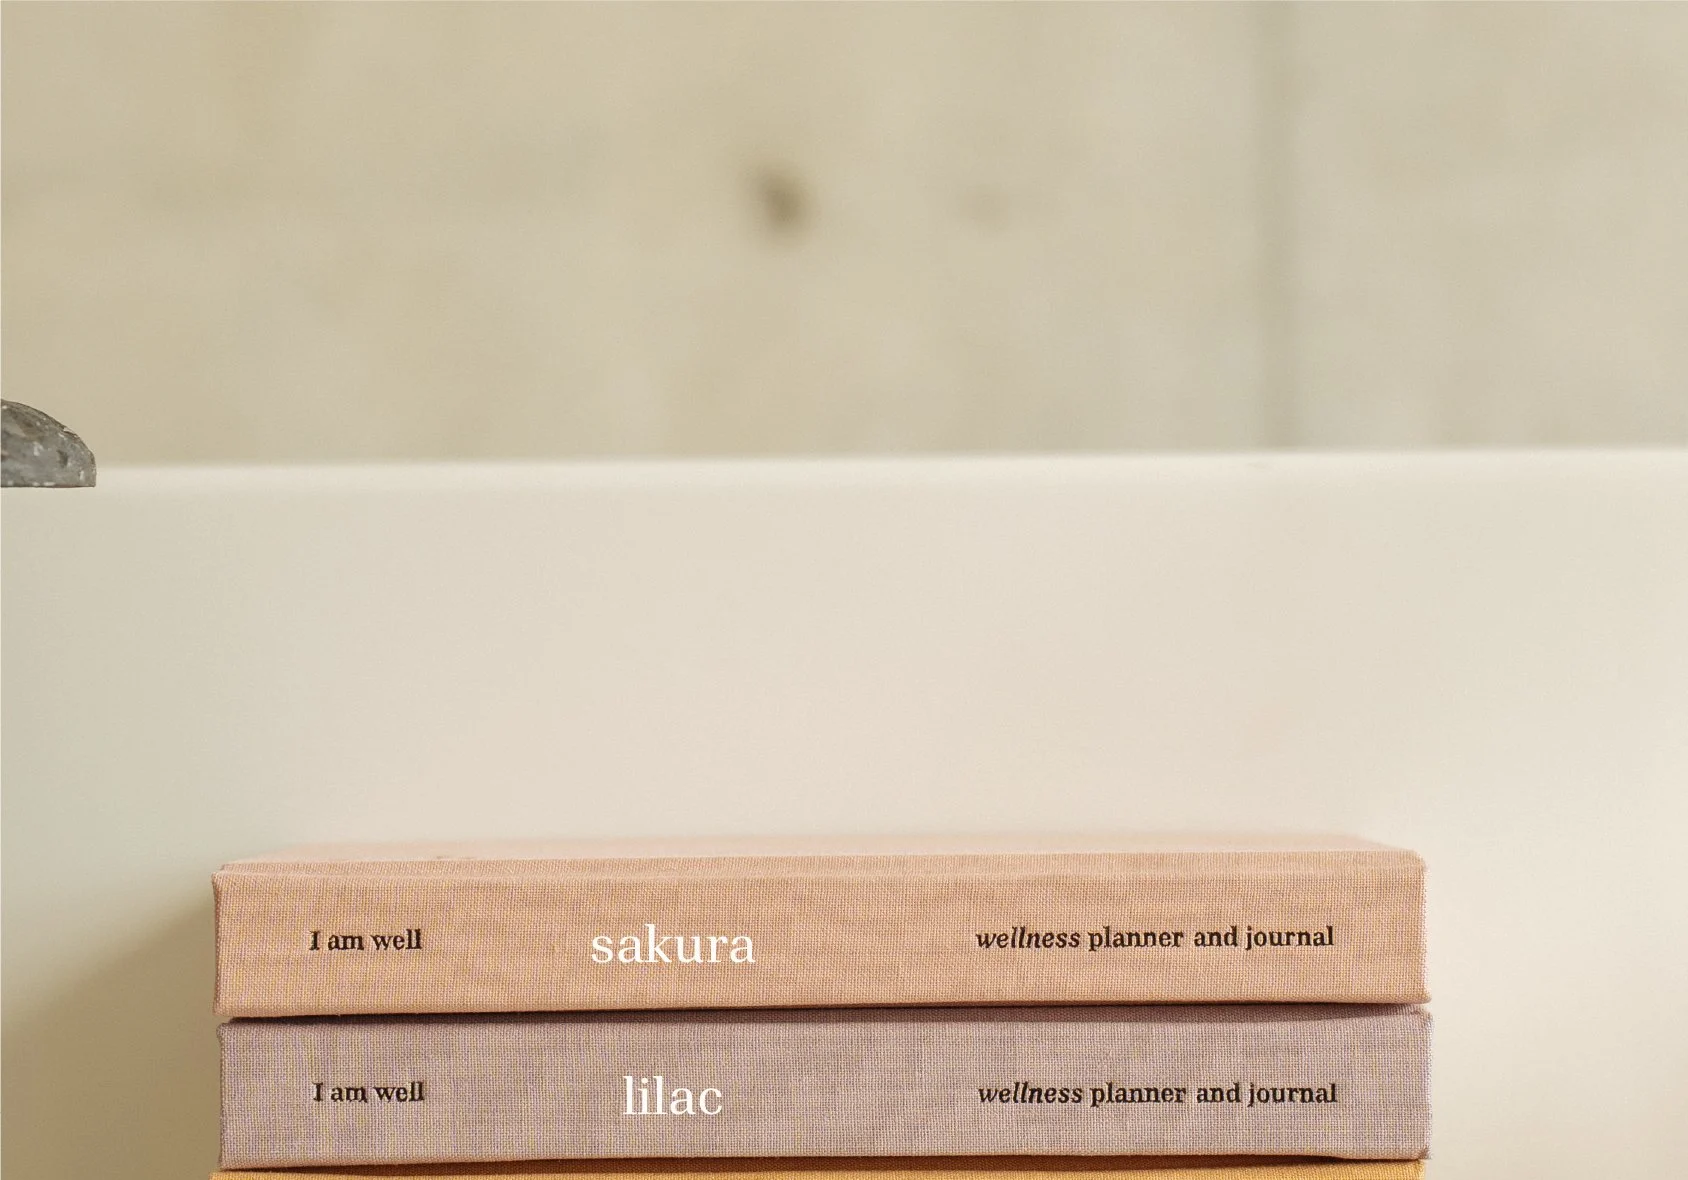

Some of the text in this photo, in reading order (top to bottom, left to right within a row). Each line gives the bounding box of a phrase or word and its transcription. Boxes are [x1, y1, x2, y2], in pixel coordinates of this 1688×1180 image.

[310, 929, 422, 950] I am well
[977, 926, 1333, 951] wellness planner and journal
[313, 1081, 424, 1103] I am well
[979, 1082, 1337, 1107] wellness planner and journal
